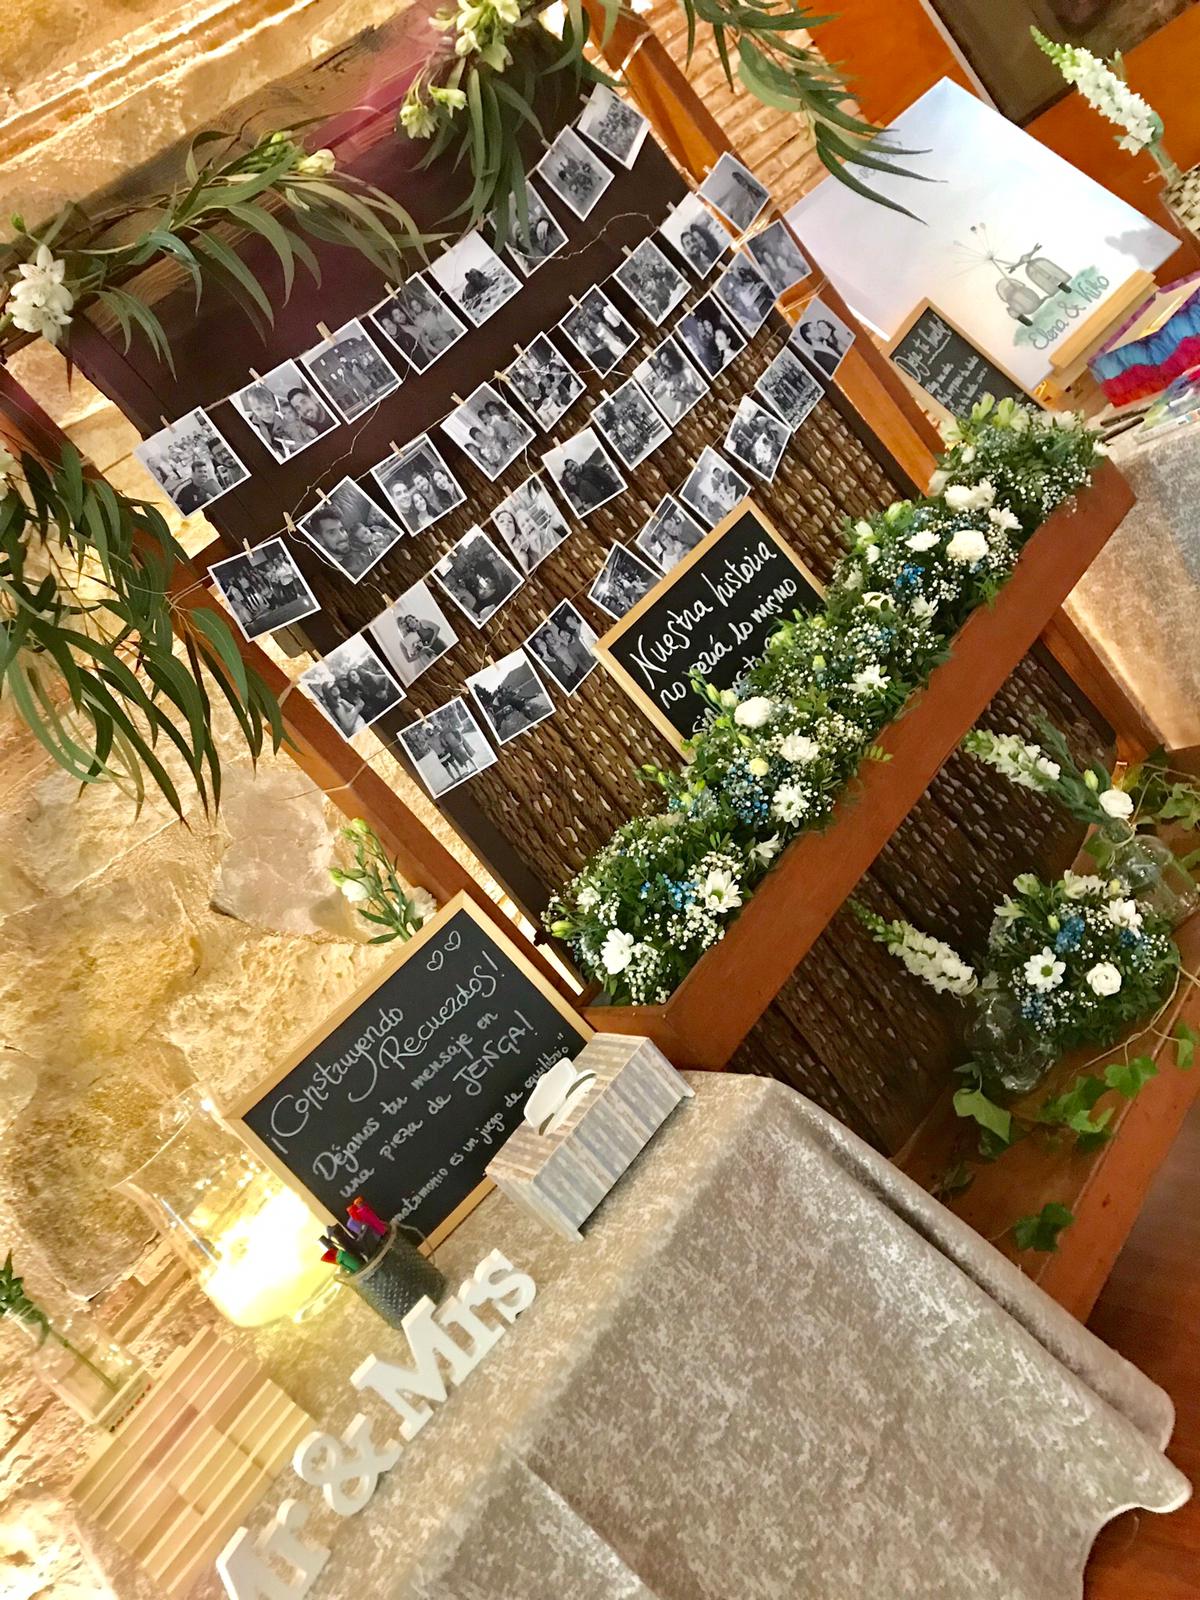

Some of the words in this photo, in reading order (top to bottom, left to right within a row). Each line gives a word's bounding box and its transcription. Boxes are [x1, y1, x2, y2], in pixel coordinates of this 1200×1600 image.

[1028, 318, 1069, 350] Elena
[1058, 299, 1087, 320] &
[629, 599, 714, 690] Nuestra
[700, 541, 778, 607] historia
[660, 681, 687, 709] no
[728, 621, 754, 645] lo
[750, 577, 797, 624] mismo
[378, 950, 505, 1070] Recuerdos!
[312, 1117, 380, 1181] Déjanos
[380, 1096, 408, 1115] tu
[410, 1032, 473, 1090] mensaje
[476, 1012, 499, 1030] en
[340, 1168, 375, 1198] una
[379, 1120, 423, 1161] pieza
[427, 1094, 452, 1115] de
[452, 1009, 538, 1096] JENGA!
[449, 1152, 464, 1166] es
[462, 1136, 479, 1152] un
[475, 1112, 505, 1145] juego
[503, 1091, 524, 1108] de
[292, 1412, 403, 1517] &
[350, 1247, 537, 1442] Mrs
